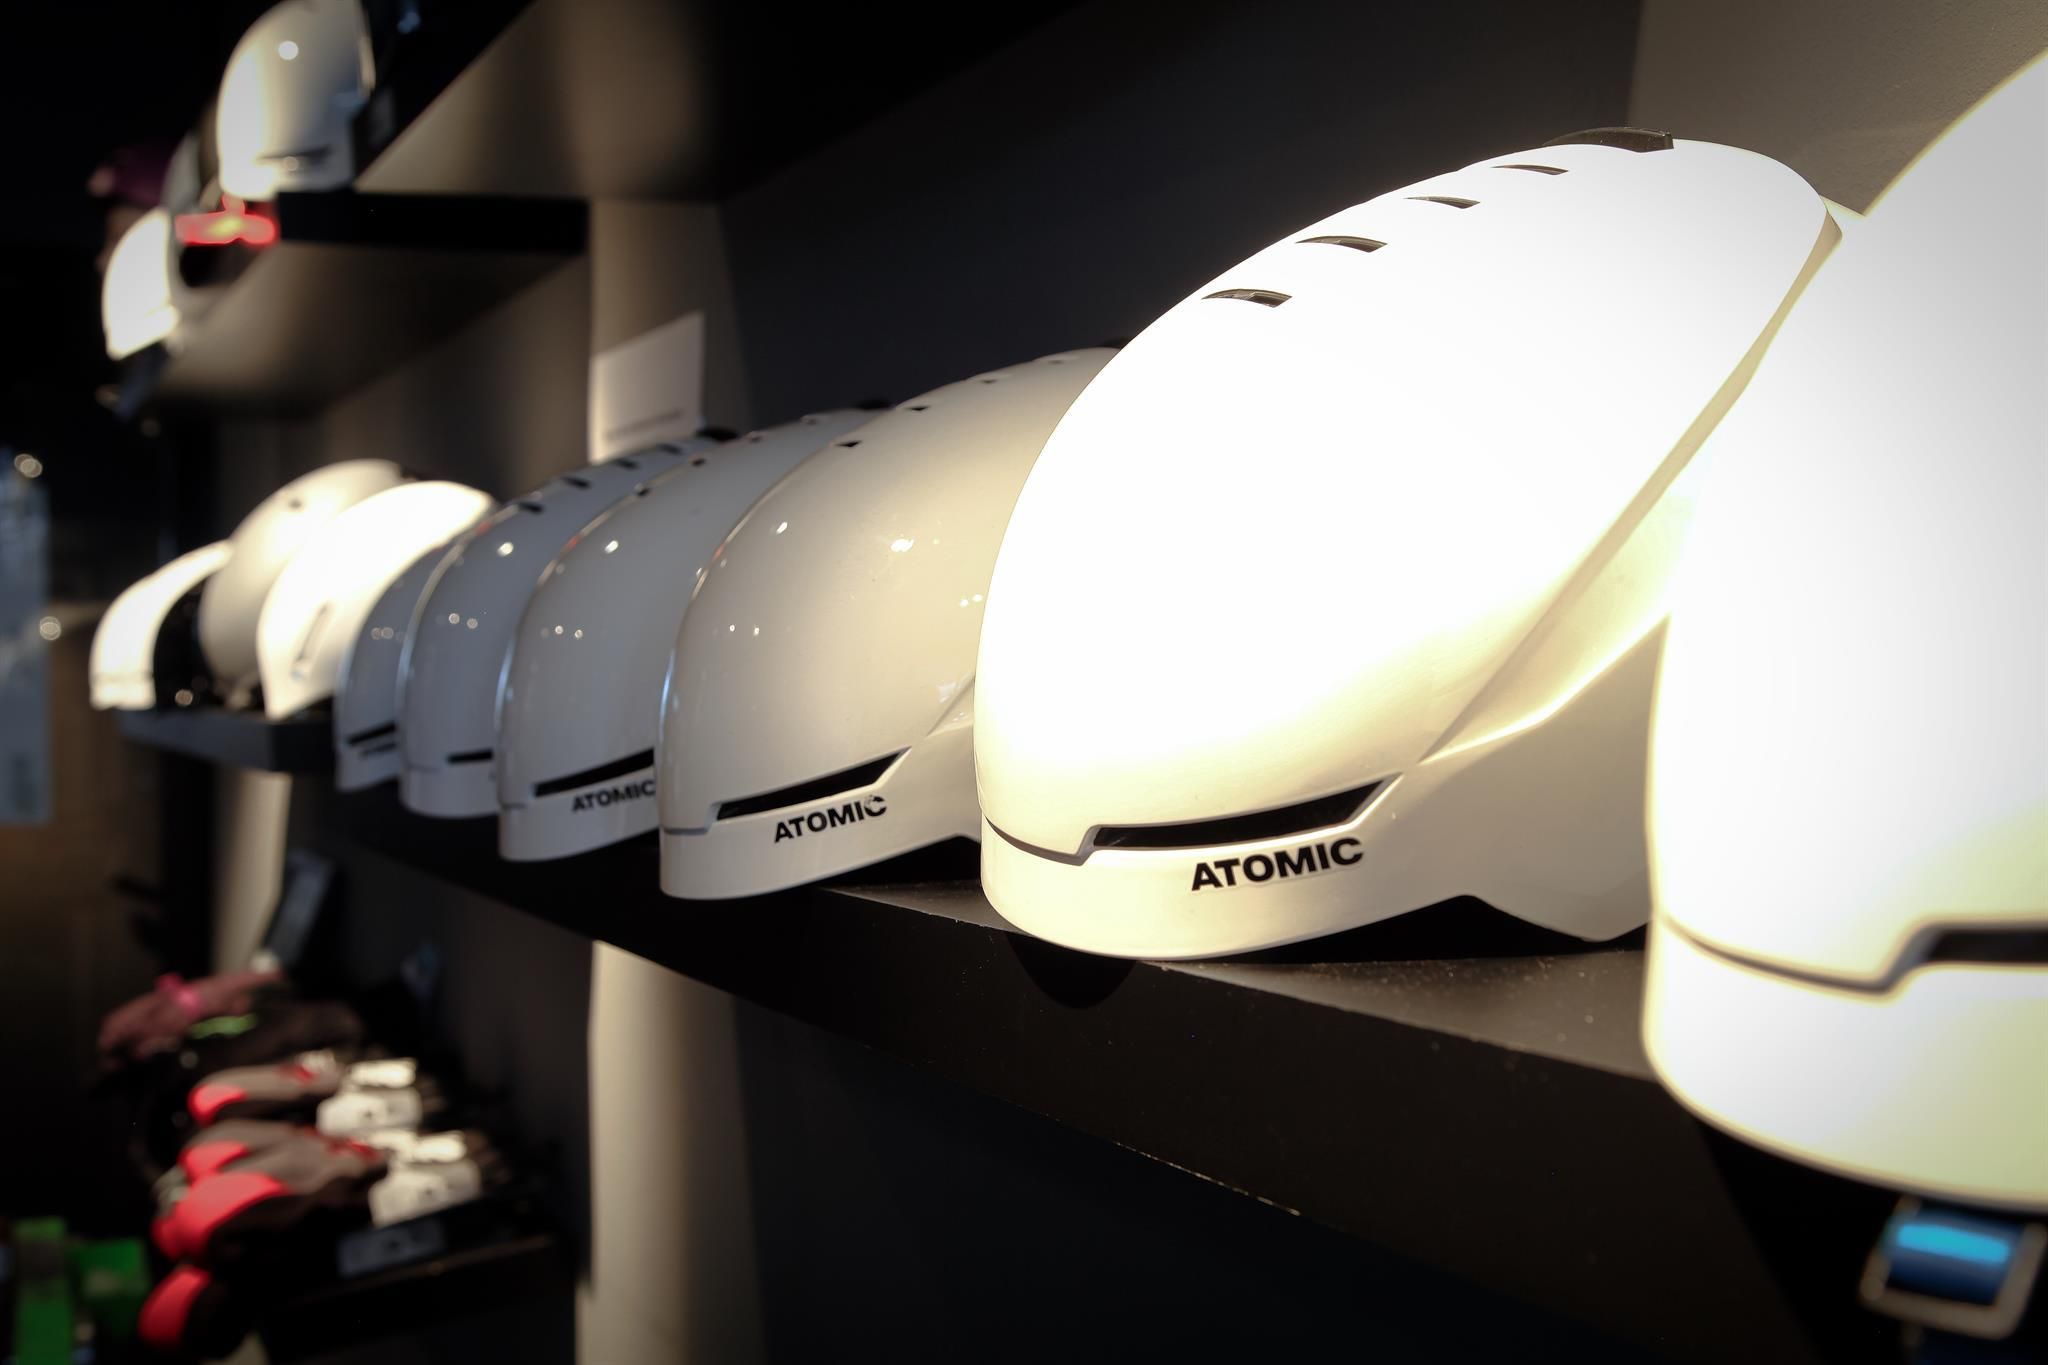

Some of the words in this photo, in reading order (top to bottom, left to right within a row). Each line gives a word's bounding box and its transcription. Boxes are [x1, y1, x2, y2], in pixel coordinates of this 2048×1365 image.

[573, 780, 656, 812] ATOMIC
[774, 795, 887, 843] ATOMIC
[1191, 837, 1364, 891] ATOMIC
